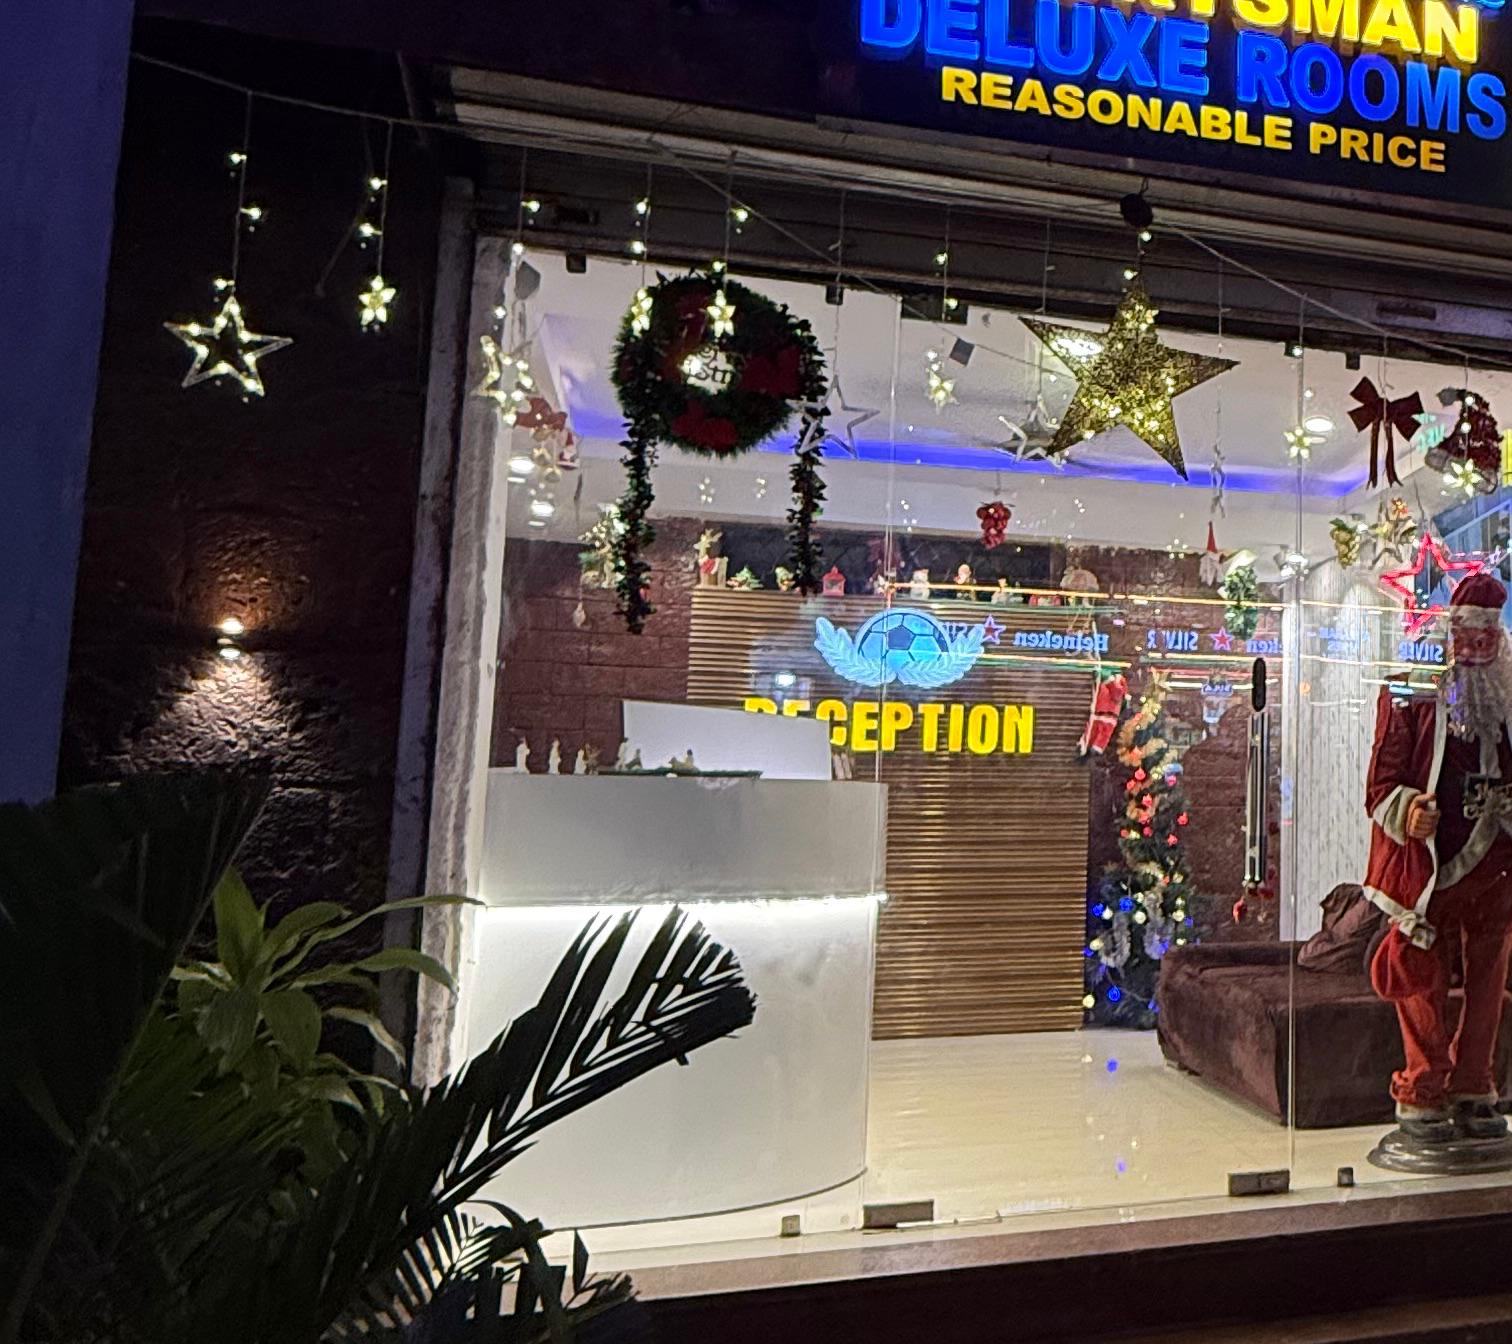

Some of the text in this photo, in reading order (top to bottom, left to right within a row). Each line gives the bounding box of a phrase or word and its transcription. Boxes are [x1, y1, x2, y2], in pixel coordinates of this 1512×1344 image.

[941, 65, 1447, 173] REASONABLE PRICE
[1236, 29, 1507, 140] ROOMS
